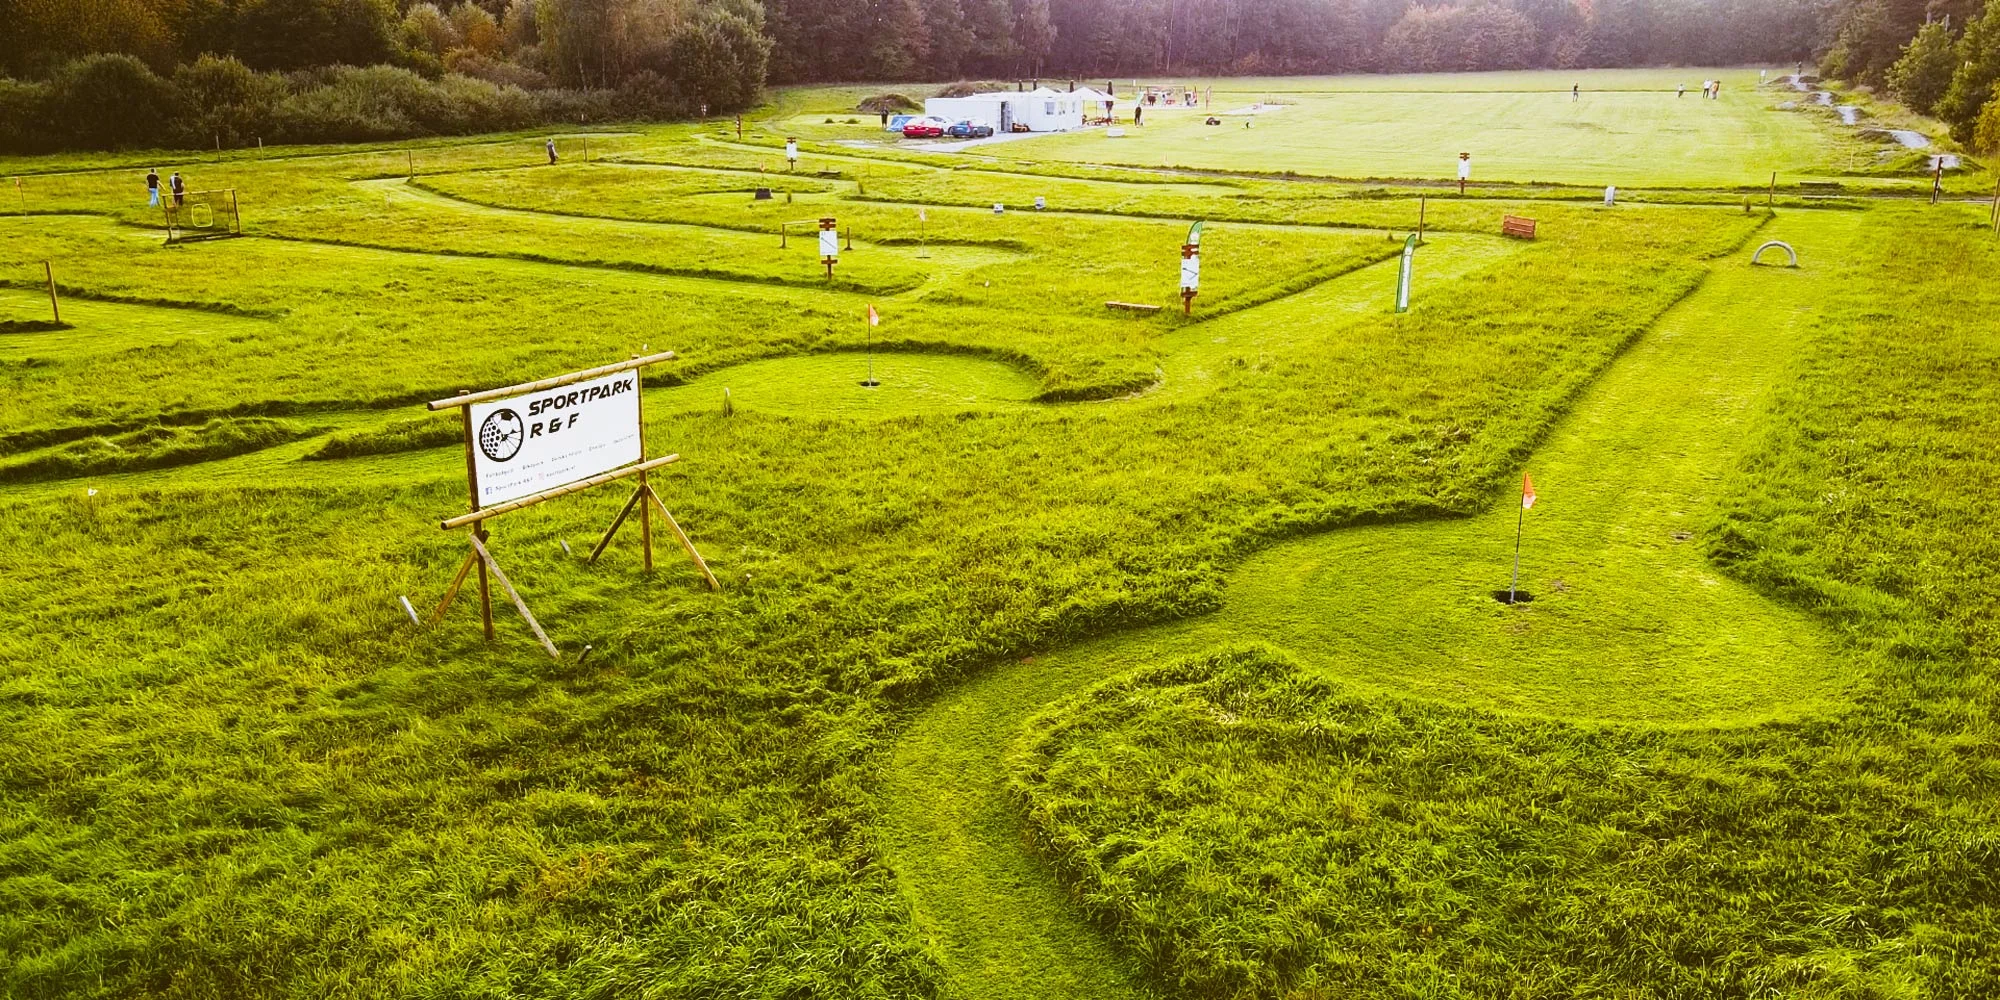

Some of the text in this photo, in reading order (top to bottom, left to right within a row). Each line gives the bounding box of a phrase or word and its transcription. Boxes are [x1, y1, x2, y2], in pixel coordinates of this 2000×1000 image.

[528, 377, 634, 416] SPORTPARK
[530, 412, 580, 438] R & F
